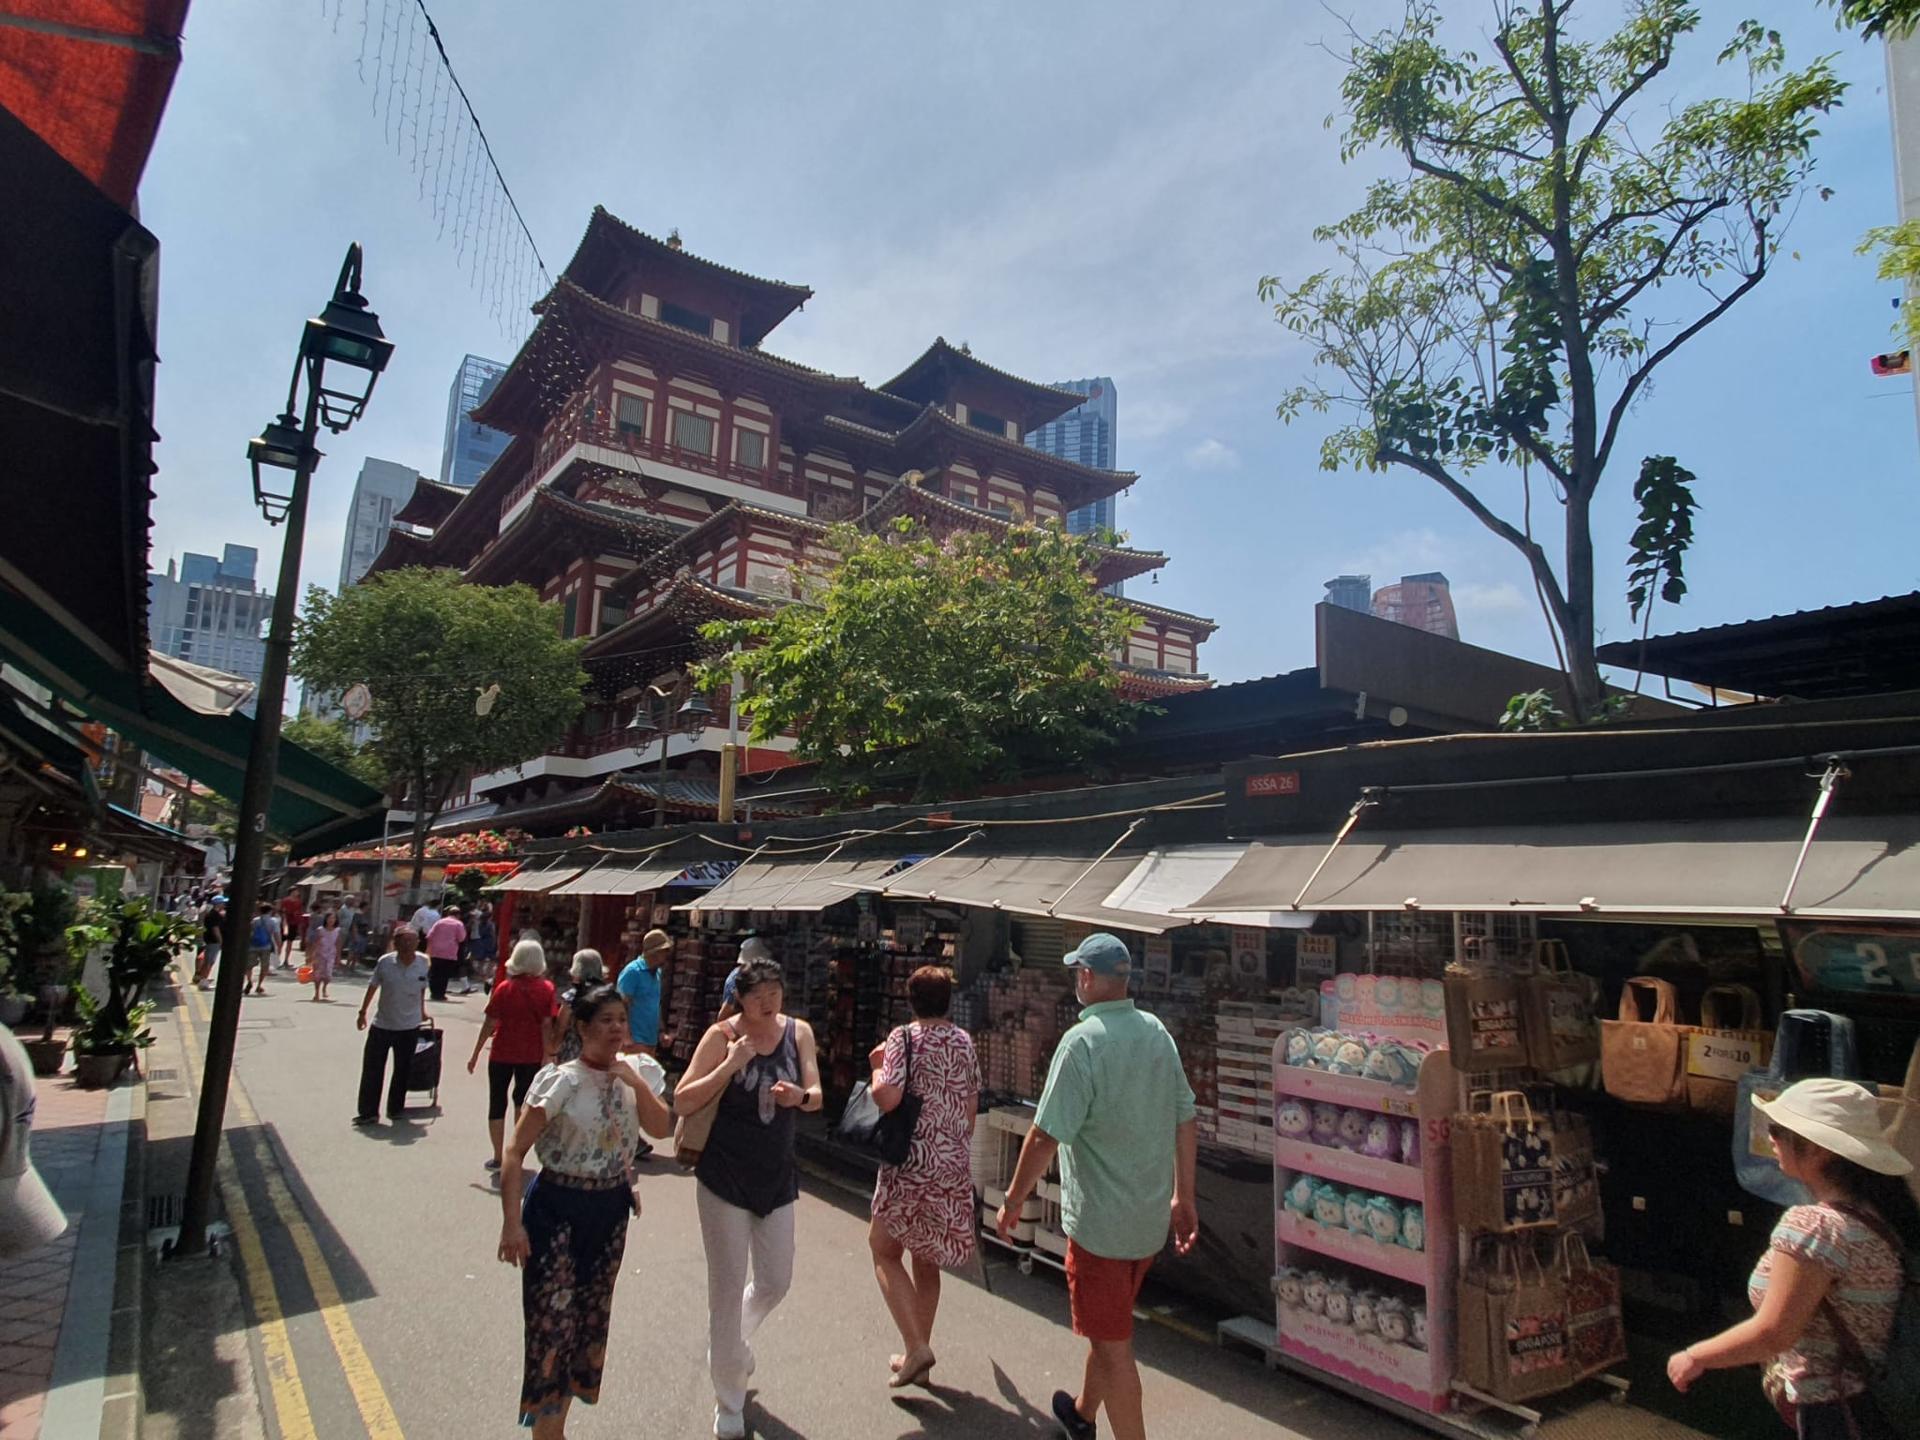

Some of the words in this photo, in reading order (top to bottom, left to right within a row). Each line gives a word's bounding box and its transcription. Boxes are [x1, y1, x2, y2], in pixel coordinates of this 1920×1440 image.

[1280, 775, 1294, 791] 26
[254, 812, 266, 833] 3
[1855, 942, 1893, 985] 2
[1703, 1044, 1713, 1058] 2
